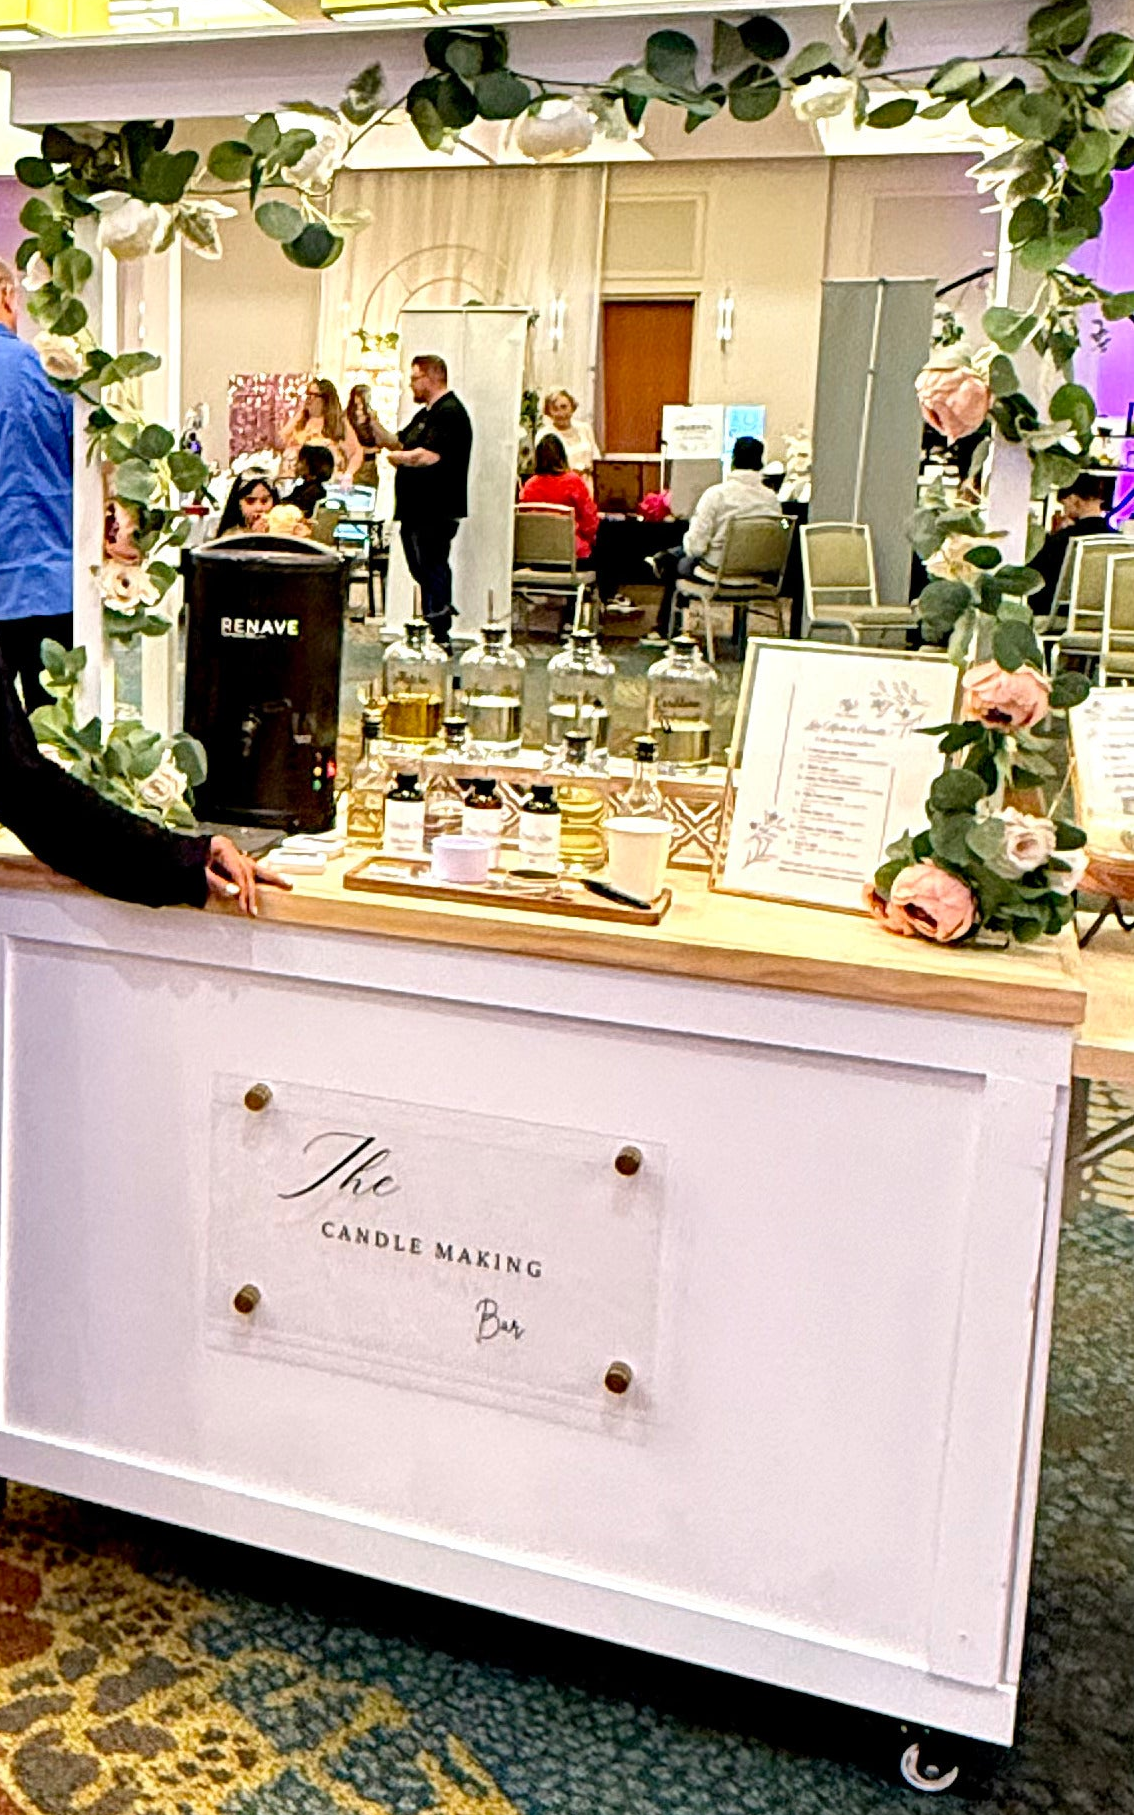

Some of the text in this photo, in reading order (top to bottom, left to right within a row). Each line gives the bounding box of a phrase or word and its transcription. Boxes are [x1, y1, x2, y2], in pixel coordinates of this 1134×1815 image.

[221, 617, 299, 636] RENAVE
[276, 1131, 402, 1200] The
[321, 1220, 544, 1279] CANDLE MAKING
[474, 1297, 526, 1343] Bar
